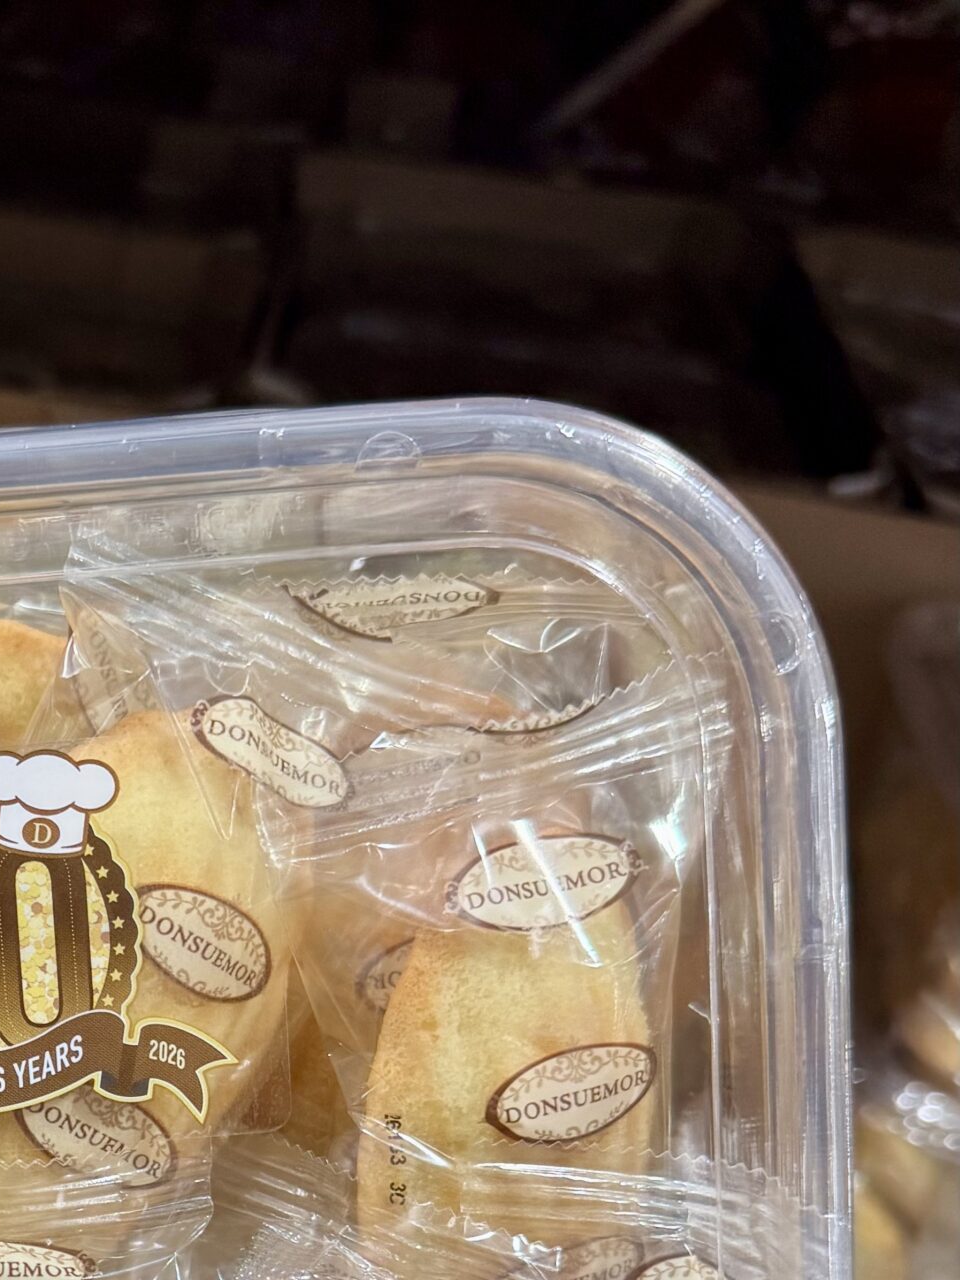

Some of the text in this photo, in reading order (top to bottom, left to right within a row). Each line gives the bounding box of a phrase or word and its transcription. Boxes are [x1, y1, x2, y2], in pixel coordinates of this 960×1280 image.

[465, 861, 628, 910] DONSUMOR
[140, 904, 257, 987] DONSUEMOR
[12, 1034, 84, 1092] YEARS
[148, 1039, 186, 1070] 2026
[503, 1069, 647, 1125] DONSUEMOR
[389, 1181, 407, 1206] 3C
